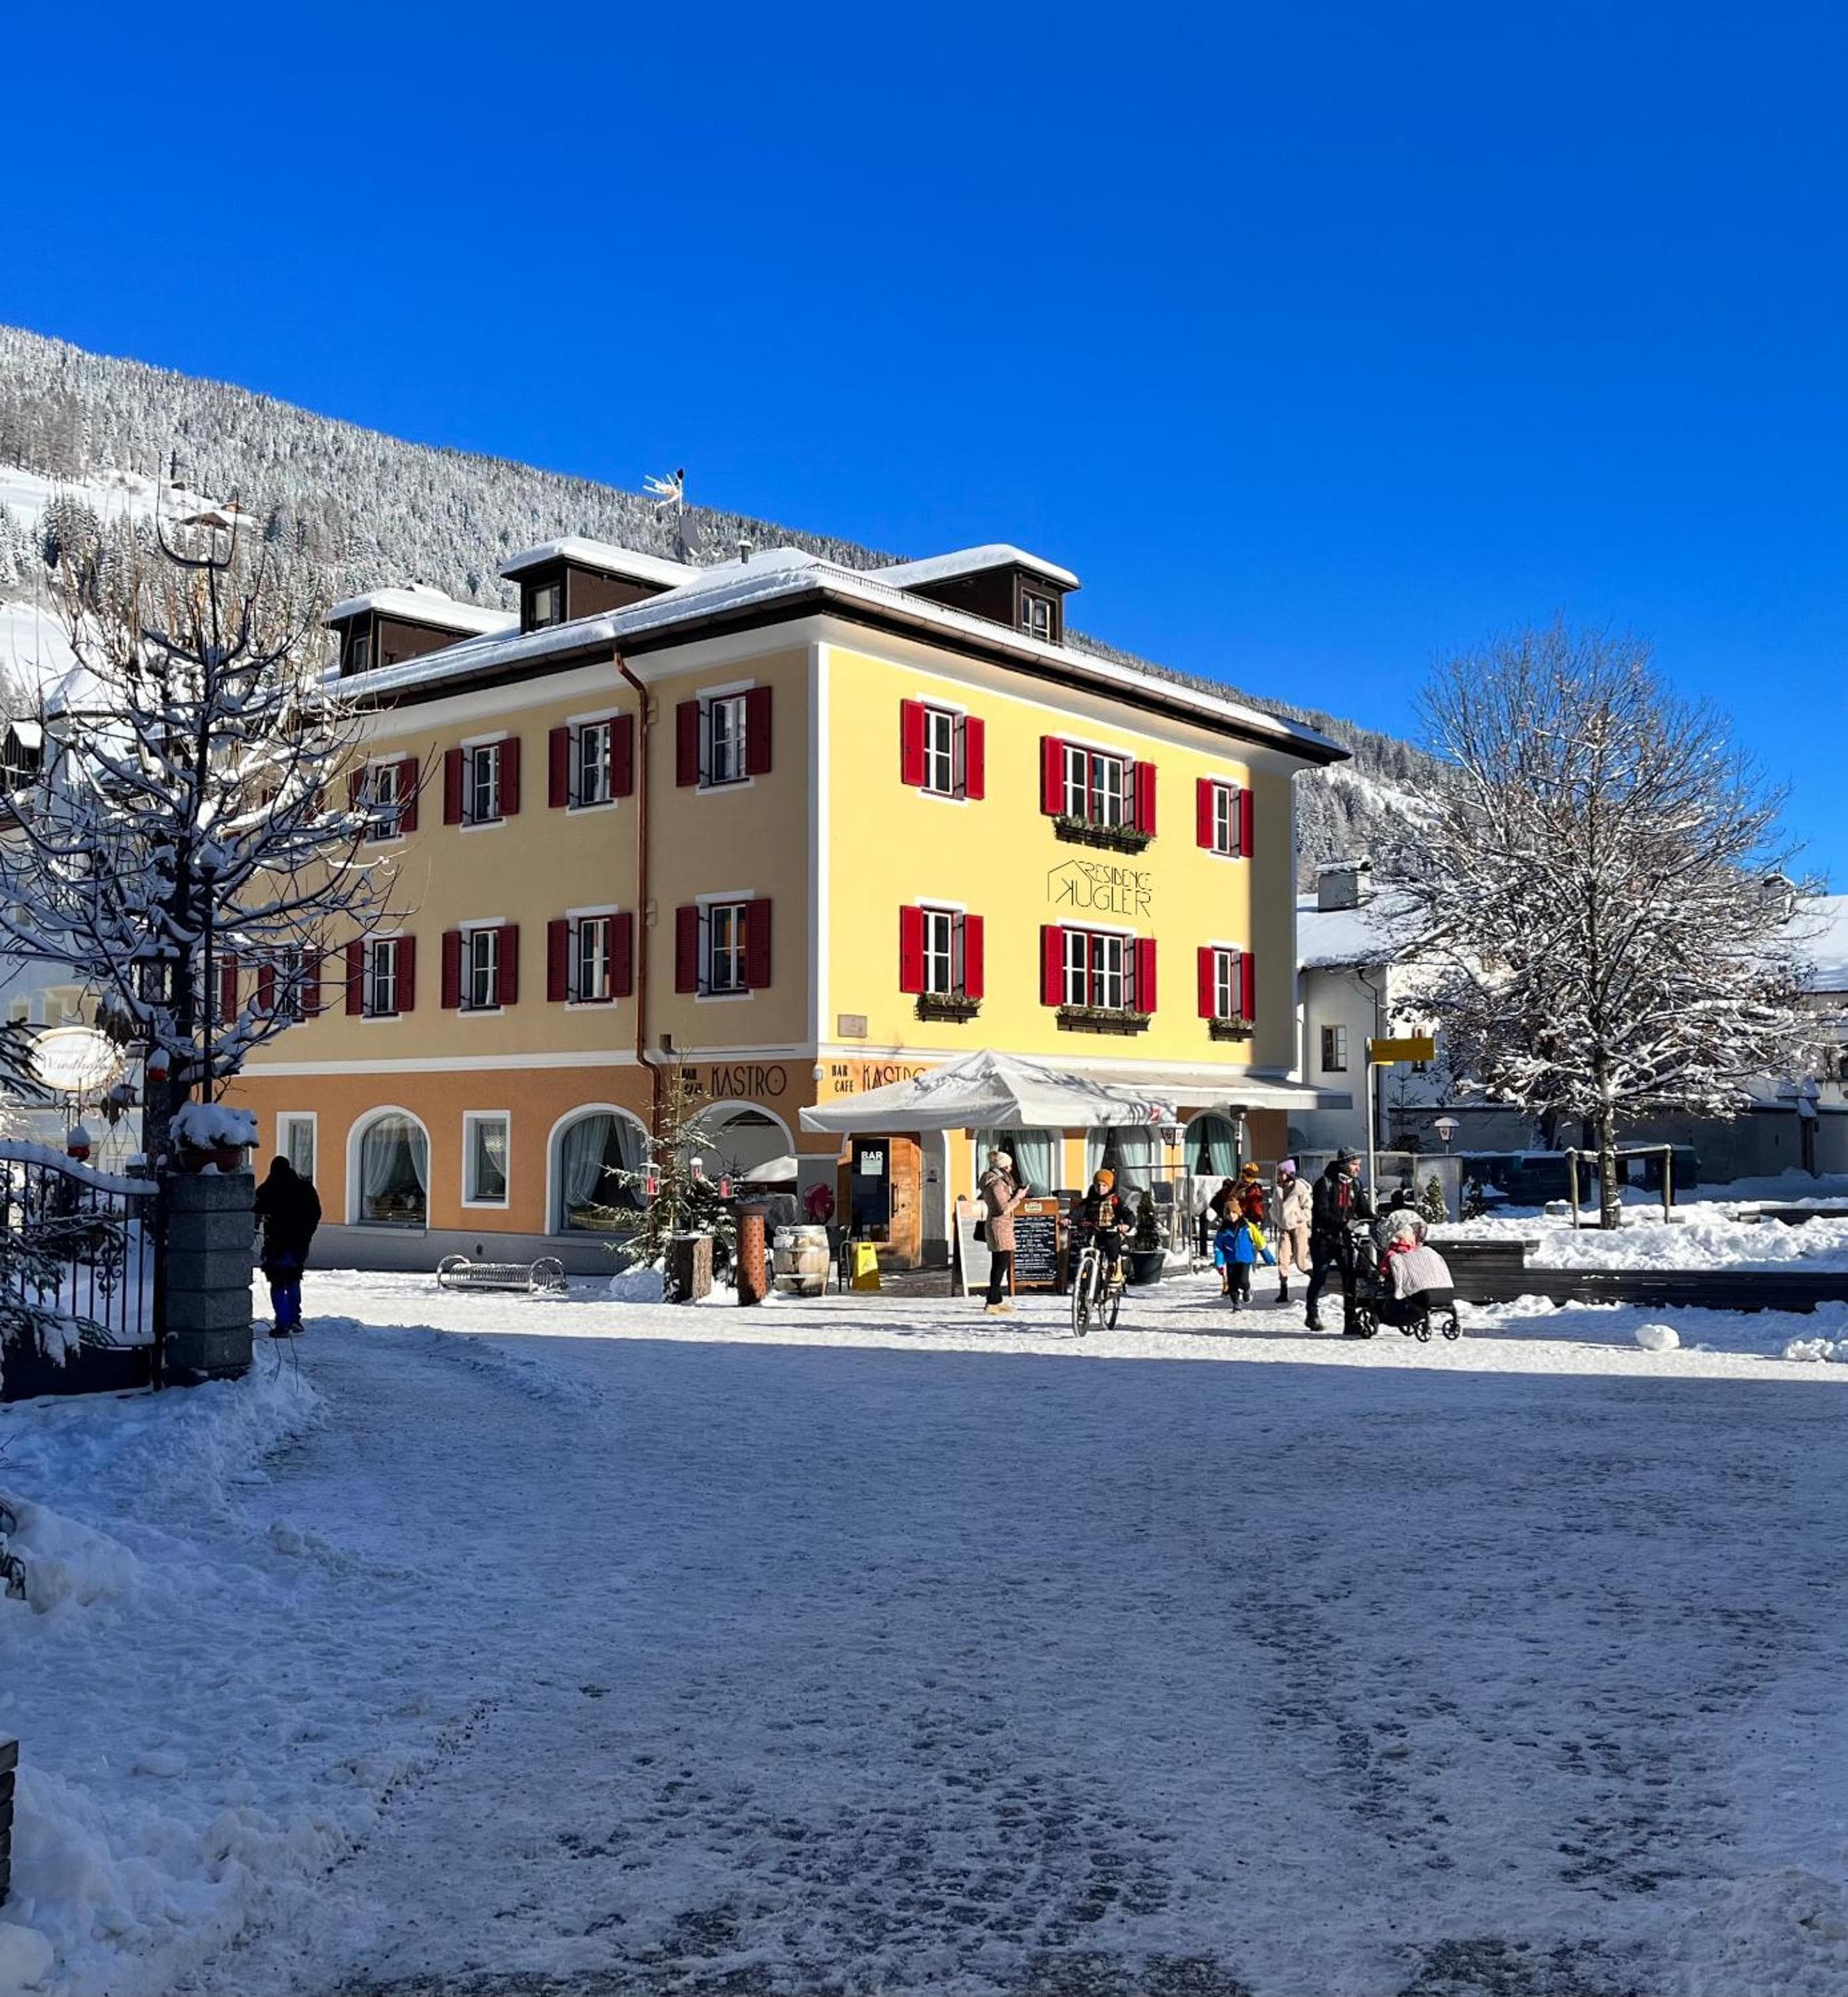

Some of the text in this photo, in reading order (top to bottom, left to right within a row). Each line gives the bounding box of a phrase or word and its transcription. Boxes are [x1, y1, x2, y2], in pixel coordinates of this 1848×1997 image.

[1078, 861, 1152, 891] RESIDENCE
[1055, 878, 1151, 918] KUGLER
[681, 1067, 697, 1080] BAR
[831, 1065, 847, 1077] BAR
[711, 1065, 787, 1097] KASTRO
[834, 1080, 854, 1092] CAFE
[861, 1151, 883, 1161] BAR
